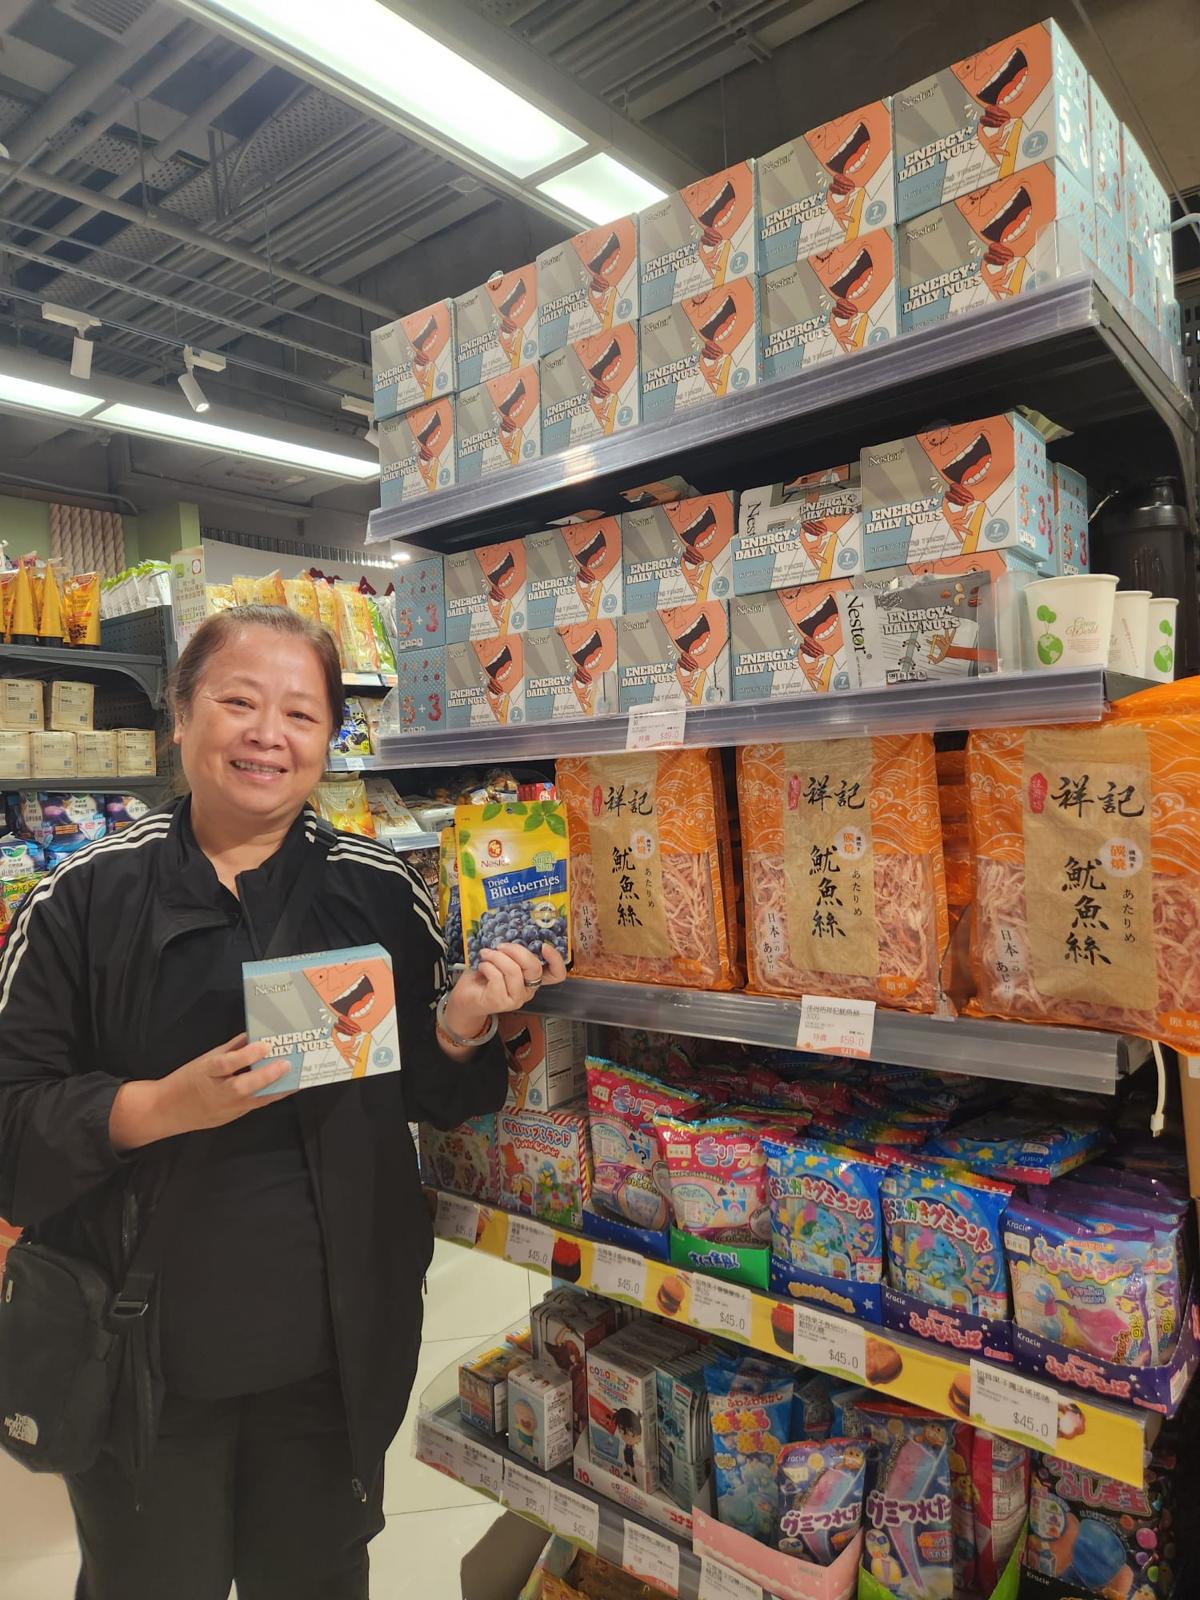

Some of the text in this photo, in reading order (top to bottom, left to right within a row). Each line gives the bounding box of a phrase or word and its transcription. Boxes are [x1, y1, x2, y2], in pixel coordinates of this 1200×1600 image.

[904, 125, 975, 167] ENERGY+
[898, 136, 980, 182] DAILY NUTS
[765, 192, 825, 227] ENERGY+
[761, 202, 829, 241] DAILY NUTS
[646, 243, 696, 271] ENERGY+
[642, 254, 700, 283] DAILY NUTS
[908, 261, 977, 299] ENERGY+
[542, 289, 586, 315] ENERGY+
[903, 274, 983, 314] DAILY NUTS
[539, 300, 590, 326] DAILY NUTS
[764, 323, 831, 359] DAILY NUTS
[769, 315, 827, 345] ENERGY+
[457, 340, 499, 363] DAILY NUTS
[459, 331, 497, 352] ENERGY+
[377, 361, 411, 382] ENERGY+
[646, 355, 696, 381] ENERGY+
[375, 370, 413, 391] DAILY NUTS
[643, 366, 700, 394] DAILY NUTS
[543, 403, 591, 428] DAILY NUTS
[546, 393, 588, 418] ENERGY+
[459, 435, 500, 458] DAILY NUTS
[461, 427, 498, 446] ENERGY+
[383, 456, 416, 472] ENERGY+
[869, 452, 902, 467] Nestor
[381, 464, 418, 483] DAILY NUTS
[872, 498, 939, 521] ENERGY+
[866, 510, 943, 534] DAILY NUTS
[740, 529, 799, 548] ENERGY+
[735, 540, 801, 561] DAILY NUTS
[626, 566, 682, 584] DAILY NUTS
[630, 556, 679, 575] ENERGY+
[528, 586, 576, 601] DAILY NUTS
[531, 576, 575, 592] ENERGY+
[447, 602, 490, 618] DAILY NUTS
[449, 593, 487, 609] ENERGY+
[400, 607, 414, 638] 5
[425, 602, 438, 632] 3
[888, 605, 954, 623] ENERGY+
[883, 617, 960, 635] DAILY NUTS
[735, 658, 800, 676] DAILY NUTS
[739, 649, 794, 664] ENERGY+
[622, 670, 677, 687] DAILY NUTS
[626, 662, 675, 676] ENERGY+
[450, 687, 485, 700] ENERGY+
[526, 684, 573, 698] DAILY NUTS
[529, 676, 572, 689] ENERGY+
[401, 695, 416, 724] 5
[428, 693, 442, 721] 3
[447, 696, 488, 708] DAILY NUTS
[603, 786, 655, 816] 祥記
[803, 774, 866, 813] 祥記
[1050, 775, 1145, 818] 祥記
[488, 876, 509, 888] Dried
[490, 875, 560, 900] Blueberries
[611, 847, 643, 928] 魷魚絲
[809, 844, 846, 939] 魷魚絲
[851, 869, 862, 917] あたりめ
[1061, 855, 1112, 966] 魷魚絲
[1121, 888, 1136, 944] あたりめ
[297, 1039, 334, 1054] NUTS
[617, 1277, 640, 1294] $45.0
[885, 1292, 906, 1305] Kracie
[719, 1311, 745, 1330] $45.0
[1017, 1331, 1041, 1348] Kracie
[829, 1349, 859, 1369] $45.0
[1012, 1411, 1049, 1437] $45.0
